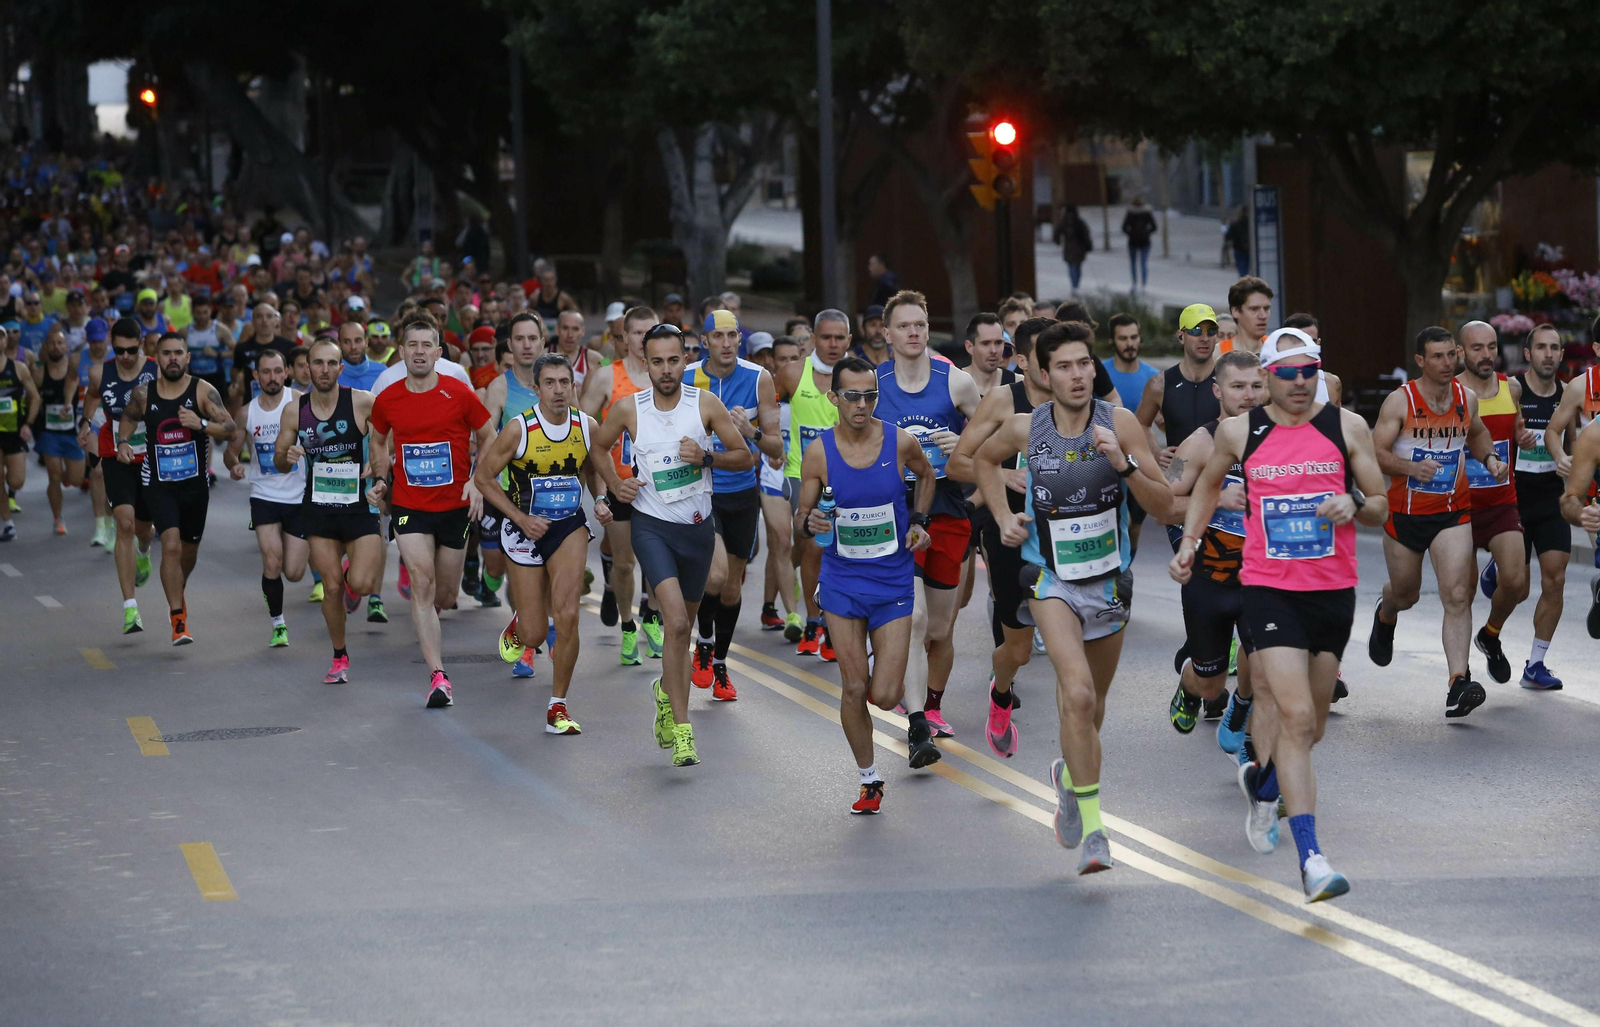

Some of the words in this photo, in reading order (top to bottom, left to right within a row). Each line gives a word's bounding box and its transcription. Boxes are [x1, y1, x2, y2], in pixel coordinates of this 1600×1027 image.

[903, 415, 933, 424] CHICAGO
[1412, 426, 1467, 439] TOBARRA
[340, 442, 357, 450] BIKE
[419, 460, 435, 469] 471
[1288, 464, 1303, 475] DE
[667, 467, 690, 481] 5025
[326, 479, 346, 488] 5036
[550, 493, 566, 503] 342
[861, 511, 886, 519] ZURICH
[1083, 518, 1109, 530] ZURICH
[1289, 520, 1312, 532] 114
[853, 527, 878, 538] 5057
[1075, 539, 1102, 553] 5031
